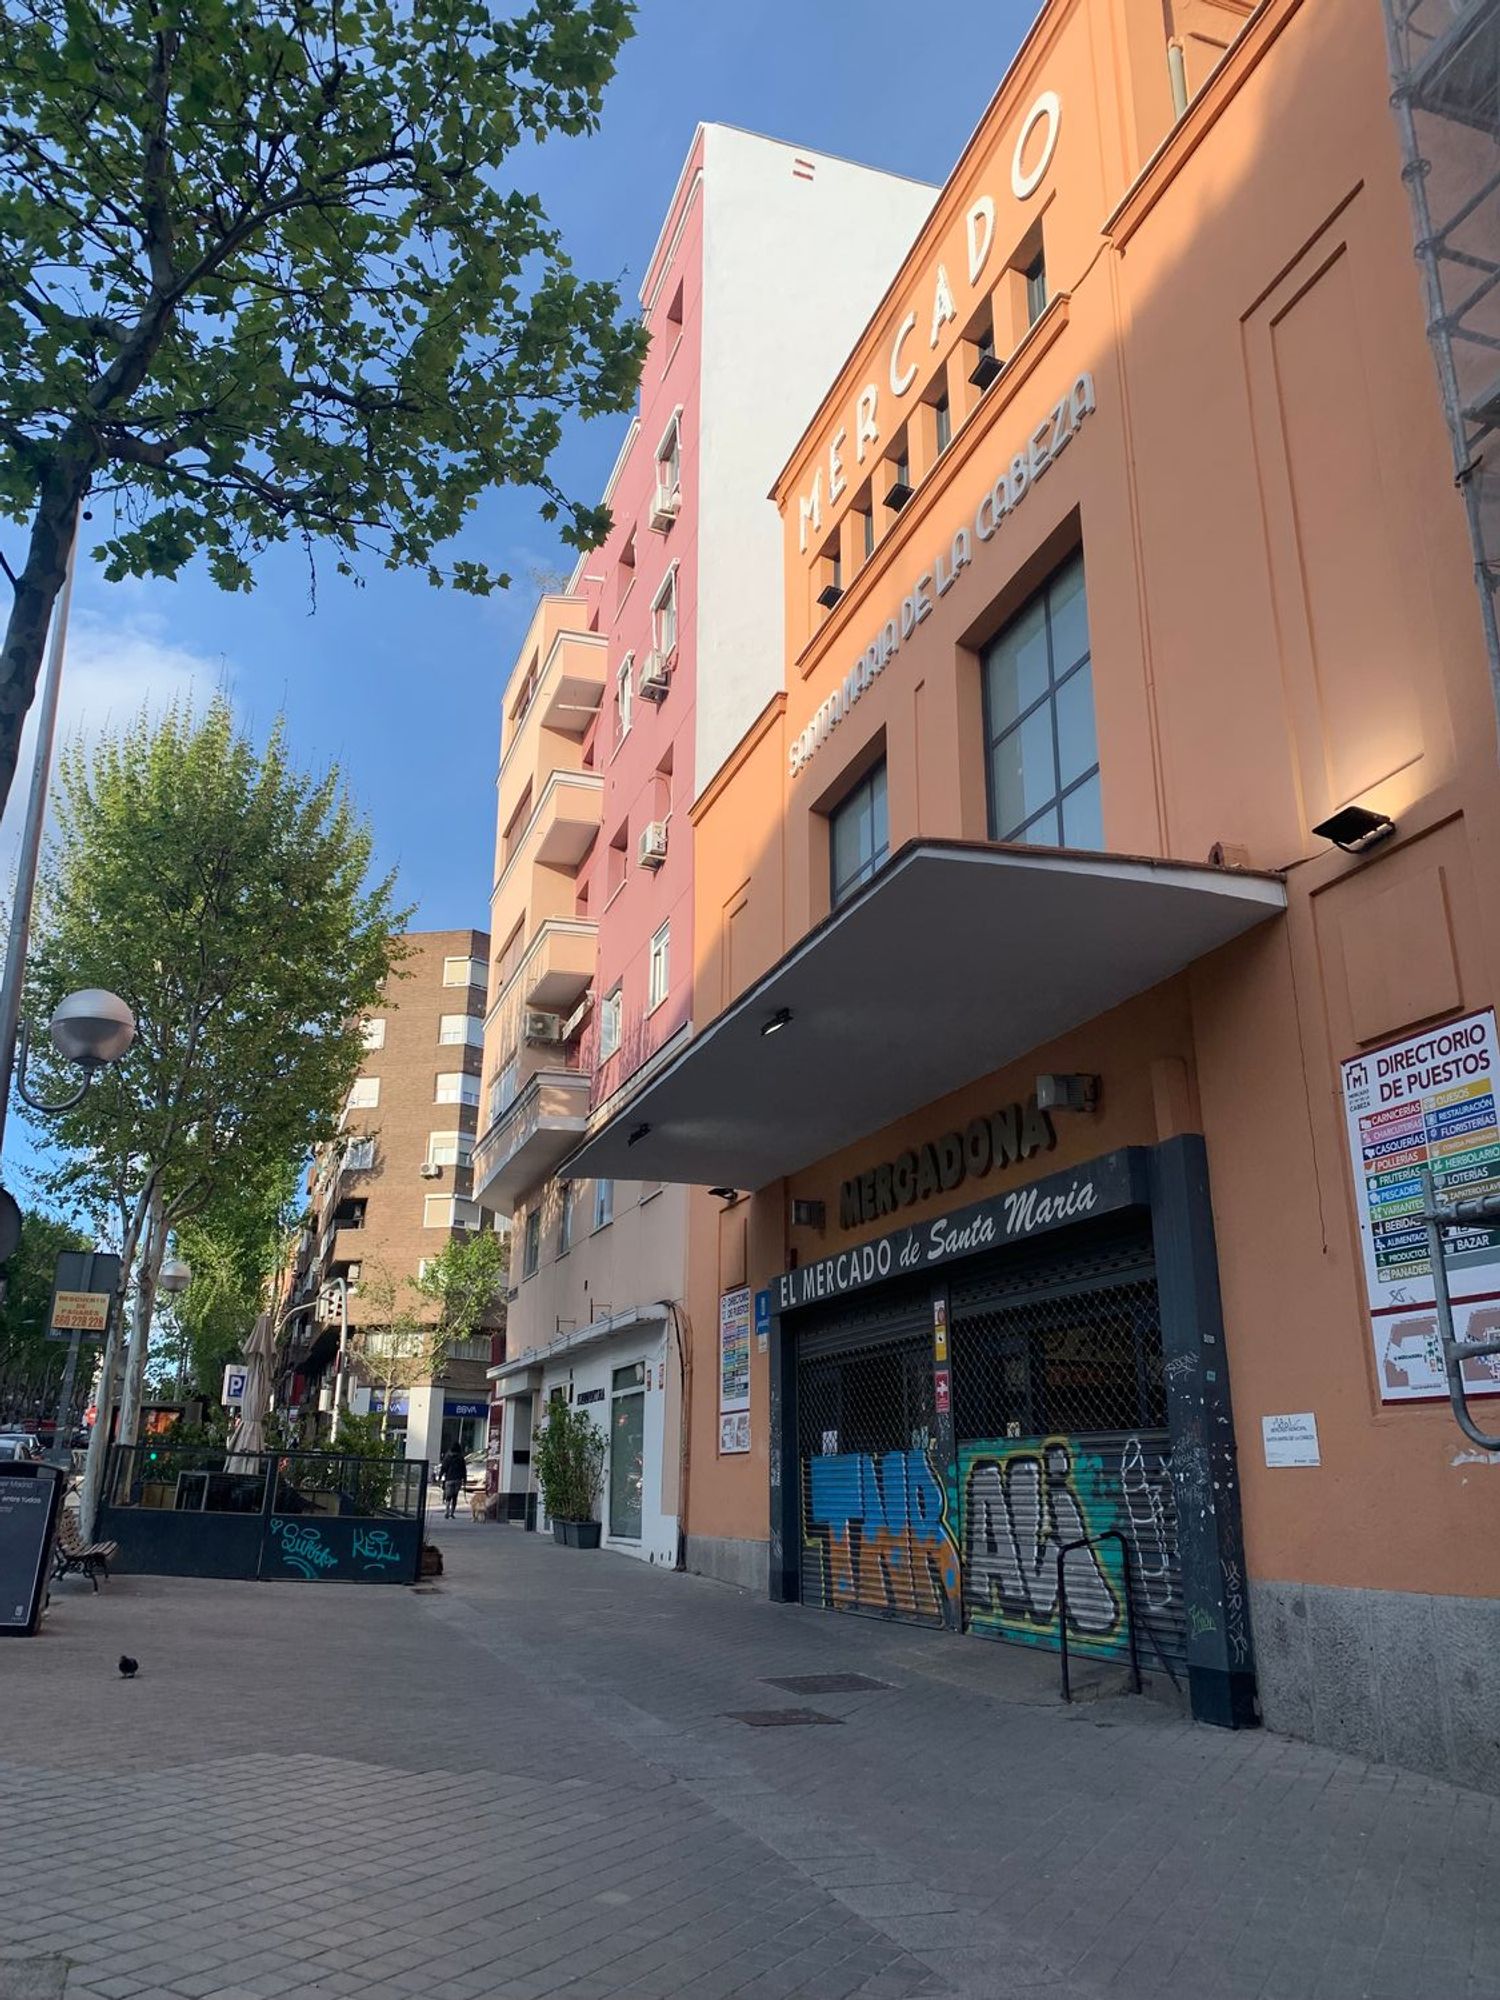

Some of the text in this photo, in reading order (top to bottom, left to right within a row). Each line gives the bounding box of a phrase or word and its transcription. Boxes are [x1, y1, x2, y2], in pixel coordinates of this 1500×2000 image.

[799, 91, 1062, 554] MERCADO
[789, 371, 1098, 778] SANTA MARIA DE LA CABEZA
[1376, 1024, 1486, 1078] DIRECTORIO
[1380, 1049, 1491, 1103] DE PUESTOS
[1436, 1088, 1470, 1106] QUESOS
[1371, 1101, 1421, 1125] CARNICERÍAS
[1438, 1098, 1493, 1120] RESTAURACIÓN
[1441, 1113, 1496, 1137] FLORISTERÍAS
[1375, 1131, 1425, 1156] CASQUERÍAS
[840, 1096, 1057, 1231] MERCADONA
[1377, 1151, 1418, 1170] POLLERÍAS
[1445, 1146, 1500, 1169] HERBOLARIO
[1380, 1168, 1421, 1186] FRUTERÍAS
[1447, 1166, 1488, 1185] LOTERÍAS
[1382, 1184, 1423, 1201] PESCADERÍ
[1383, 1198, 1425, 1216] VARIANTES
[1457, 1234, 1490, 1251] BAZAR
[780, 1277, 797, 1308] EL
[803, 1238, 892, 1301] MERCADO
[899, 1227, 922, 1268] de
[927, 1214, 997, 1262] Santa
[1389, 1247, 1427, 1262] PRODUCTOS
[1390, 1264, 1433, 1280] PANADERÍ
[229, 1376, 242, 1396] P
[376, 1403, 401, 1412] BVA
[456, 1405, 477, 1414] BBVA
